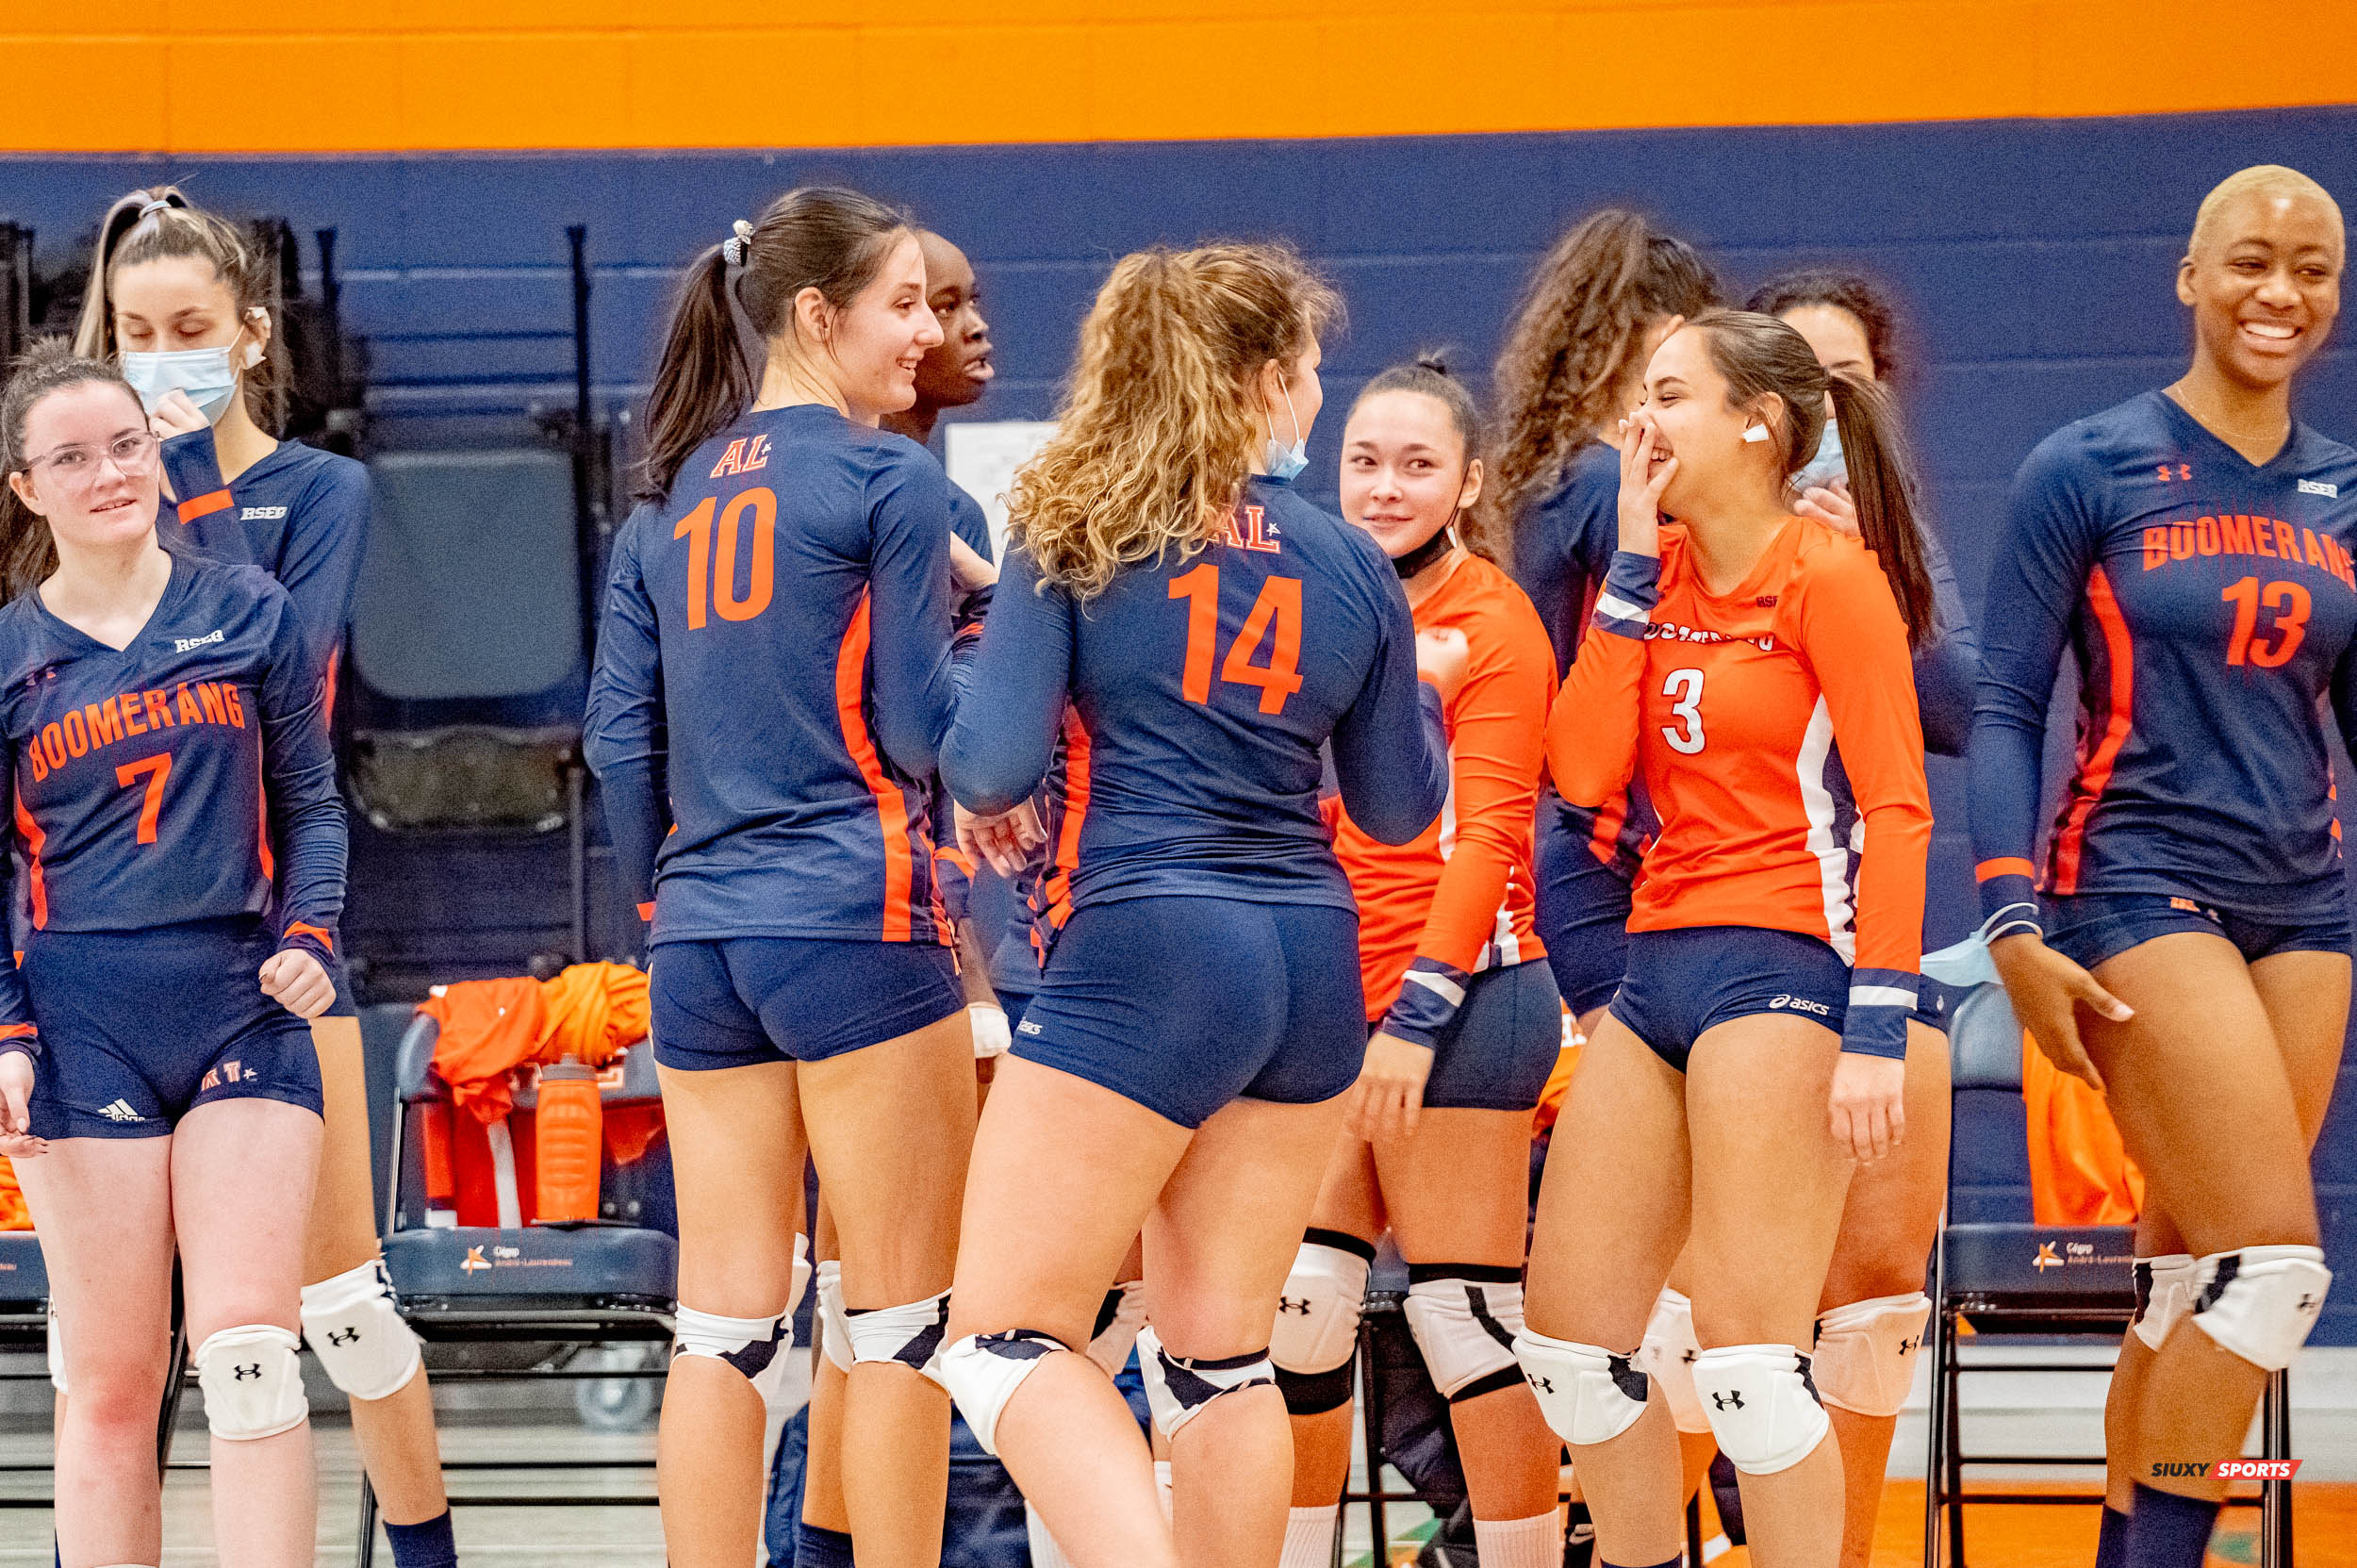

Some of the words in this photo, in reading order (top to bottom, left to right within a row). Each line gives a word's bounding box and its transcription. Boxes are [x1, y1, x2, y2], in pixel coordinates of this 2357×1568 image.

[709, 434, 769, 478] AL
[673, 487, 778, 631] 10
[1168, 563, 1304, 716] 14
[2222, 576, 2312, 668] 13
[28, 682, 245, 783] BOOMERANG
[1660, 668, 1706, 755] 3
[115, 751, 173, 845] 7
[1789, 998, 1830, 1015] asics
